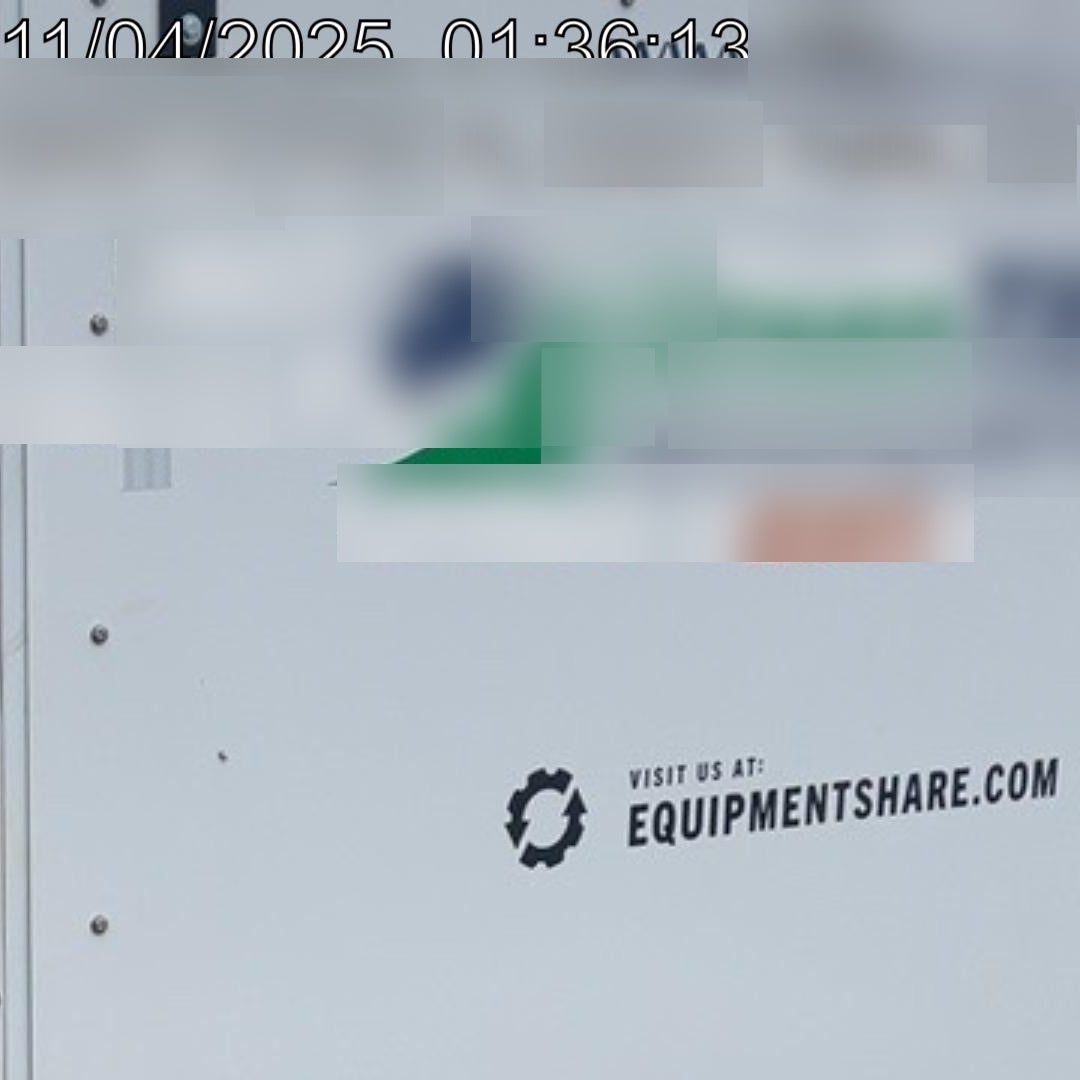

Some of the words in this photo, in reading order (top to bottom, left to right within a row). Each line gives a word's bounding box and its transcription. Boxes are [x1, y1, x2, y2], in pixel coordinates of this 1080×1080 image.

[628, 757, 1059, 848] EQUIPMENTSHARE.COM
[629, 763, 687, 790] VISIT
[695, 760, 722, 783] US
[731, 756, 764, 778] AT:
